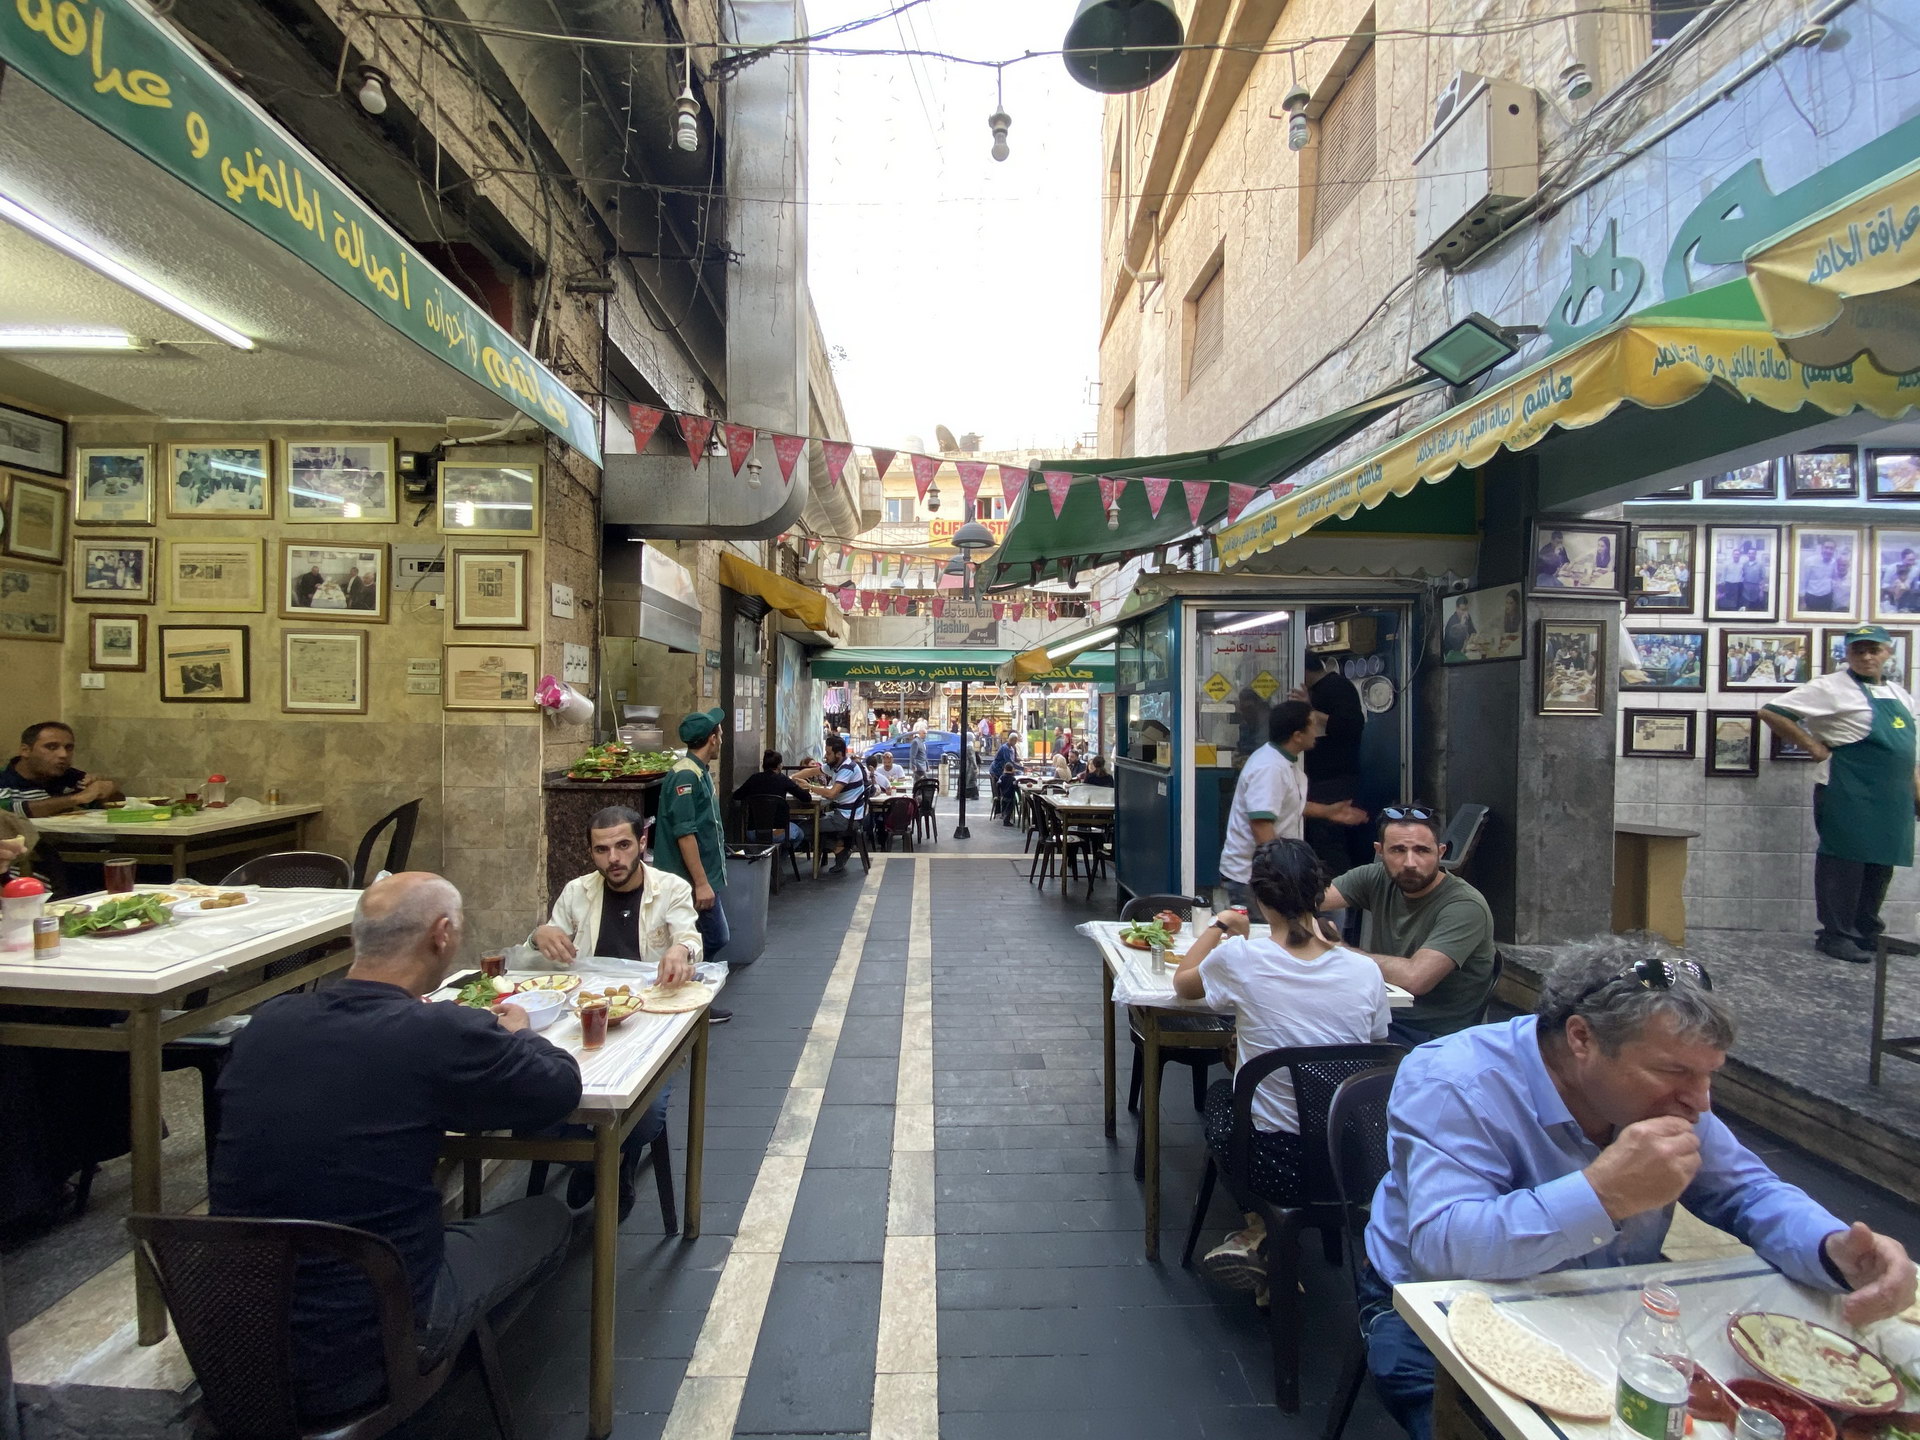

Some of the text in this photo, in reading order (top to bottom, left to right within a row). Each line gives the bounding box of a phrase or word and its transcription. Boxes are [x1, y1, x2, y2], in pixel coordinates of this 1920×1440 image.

[186, 111, 209, 159] و
[220, 147, 326, 242] الماضي
[1808, 222, 1863, 285] الحاضر
[482, 346, 569, 428] هاشم
[1522, 367, 1573, 424] هاشم
[1357, 461, 1383, 496] هاشم
[932, 521, 966, 536] CLIF
[942, 603, 993, 618] estauran
[936, 620, 970, 634] Hashim
[845, 664, 881, 676] الحاضر
[918, 669, 927, 677] و
[928, 666, 960, 680] الماضي
